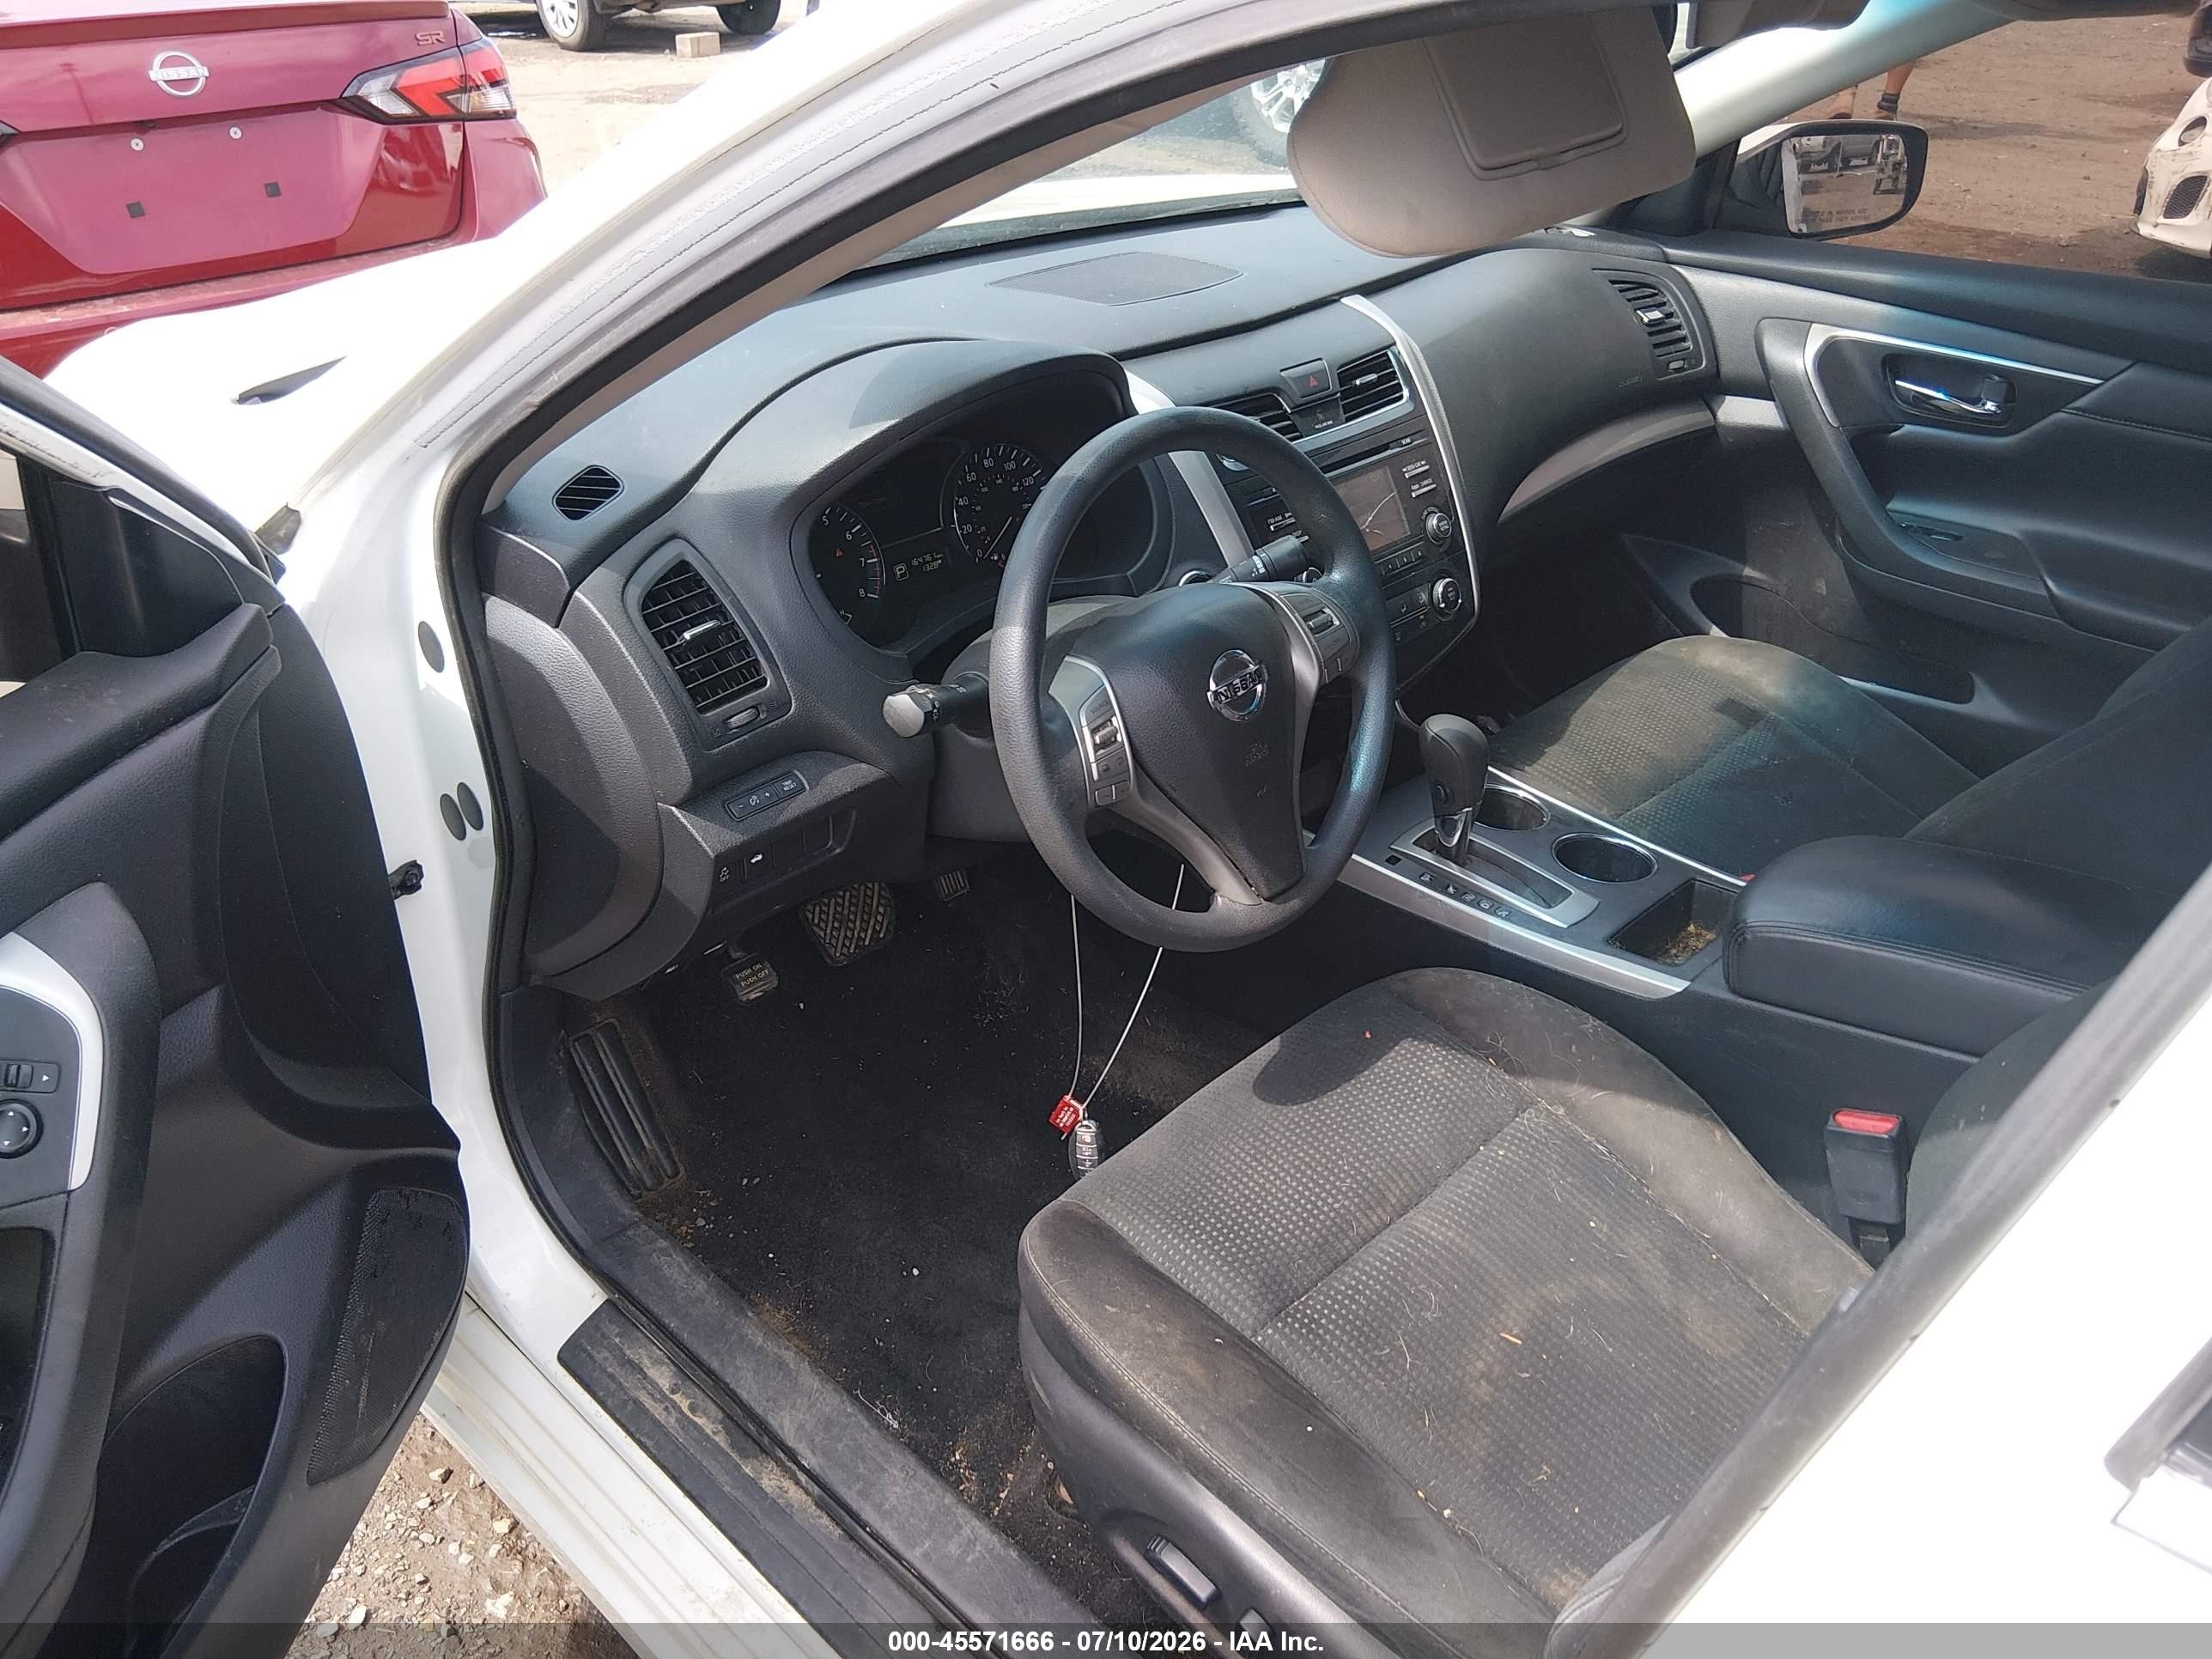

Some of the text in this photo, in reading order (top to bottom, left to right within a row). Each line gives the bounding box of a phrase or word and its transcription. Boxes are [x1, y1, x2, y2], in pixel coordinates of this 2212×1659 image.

[415, 30, 447, 46] SR
[152, 67, 209, 80] NISSAN
[983, 458, 994, 468] 80
[1004, 461, 1016, 471] 100
[966, 472, 976, 482] 60
[1023, 477, 1034, 486] 120
[958, 496, 969, 506] 40
[823, 516, 829, 526] 5
[962, 524, 972, 534] 20
[846, 531, 853, 540] 6
[860, 558, 865, 567] 7
[859, 589, 866, 598] 8
[1216, 666, 1262, 702] NISSAN
[735, 968, 753, 979] PUSH
[740, 969, 769, 988] PUSH OFF
